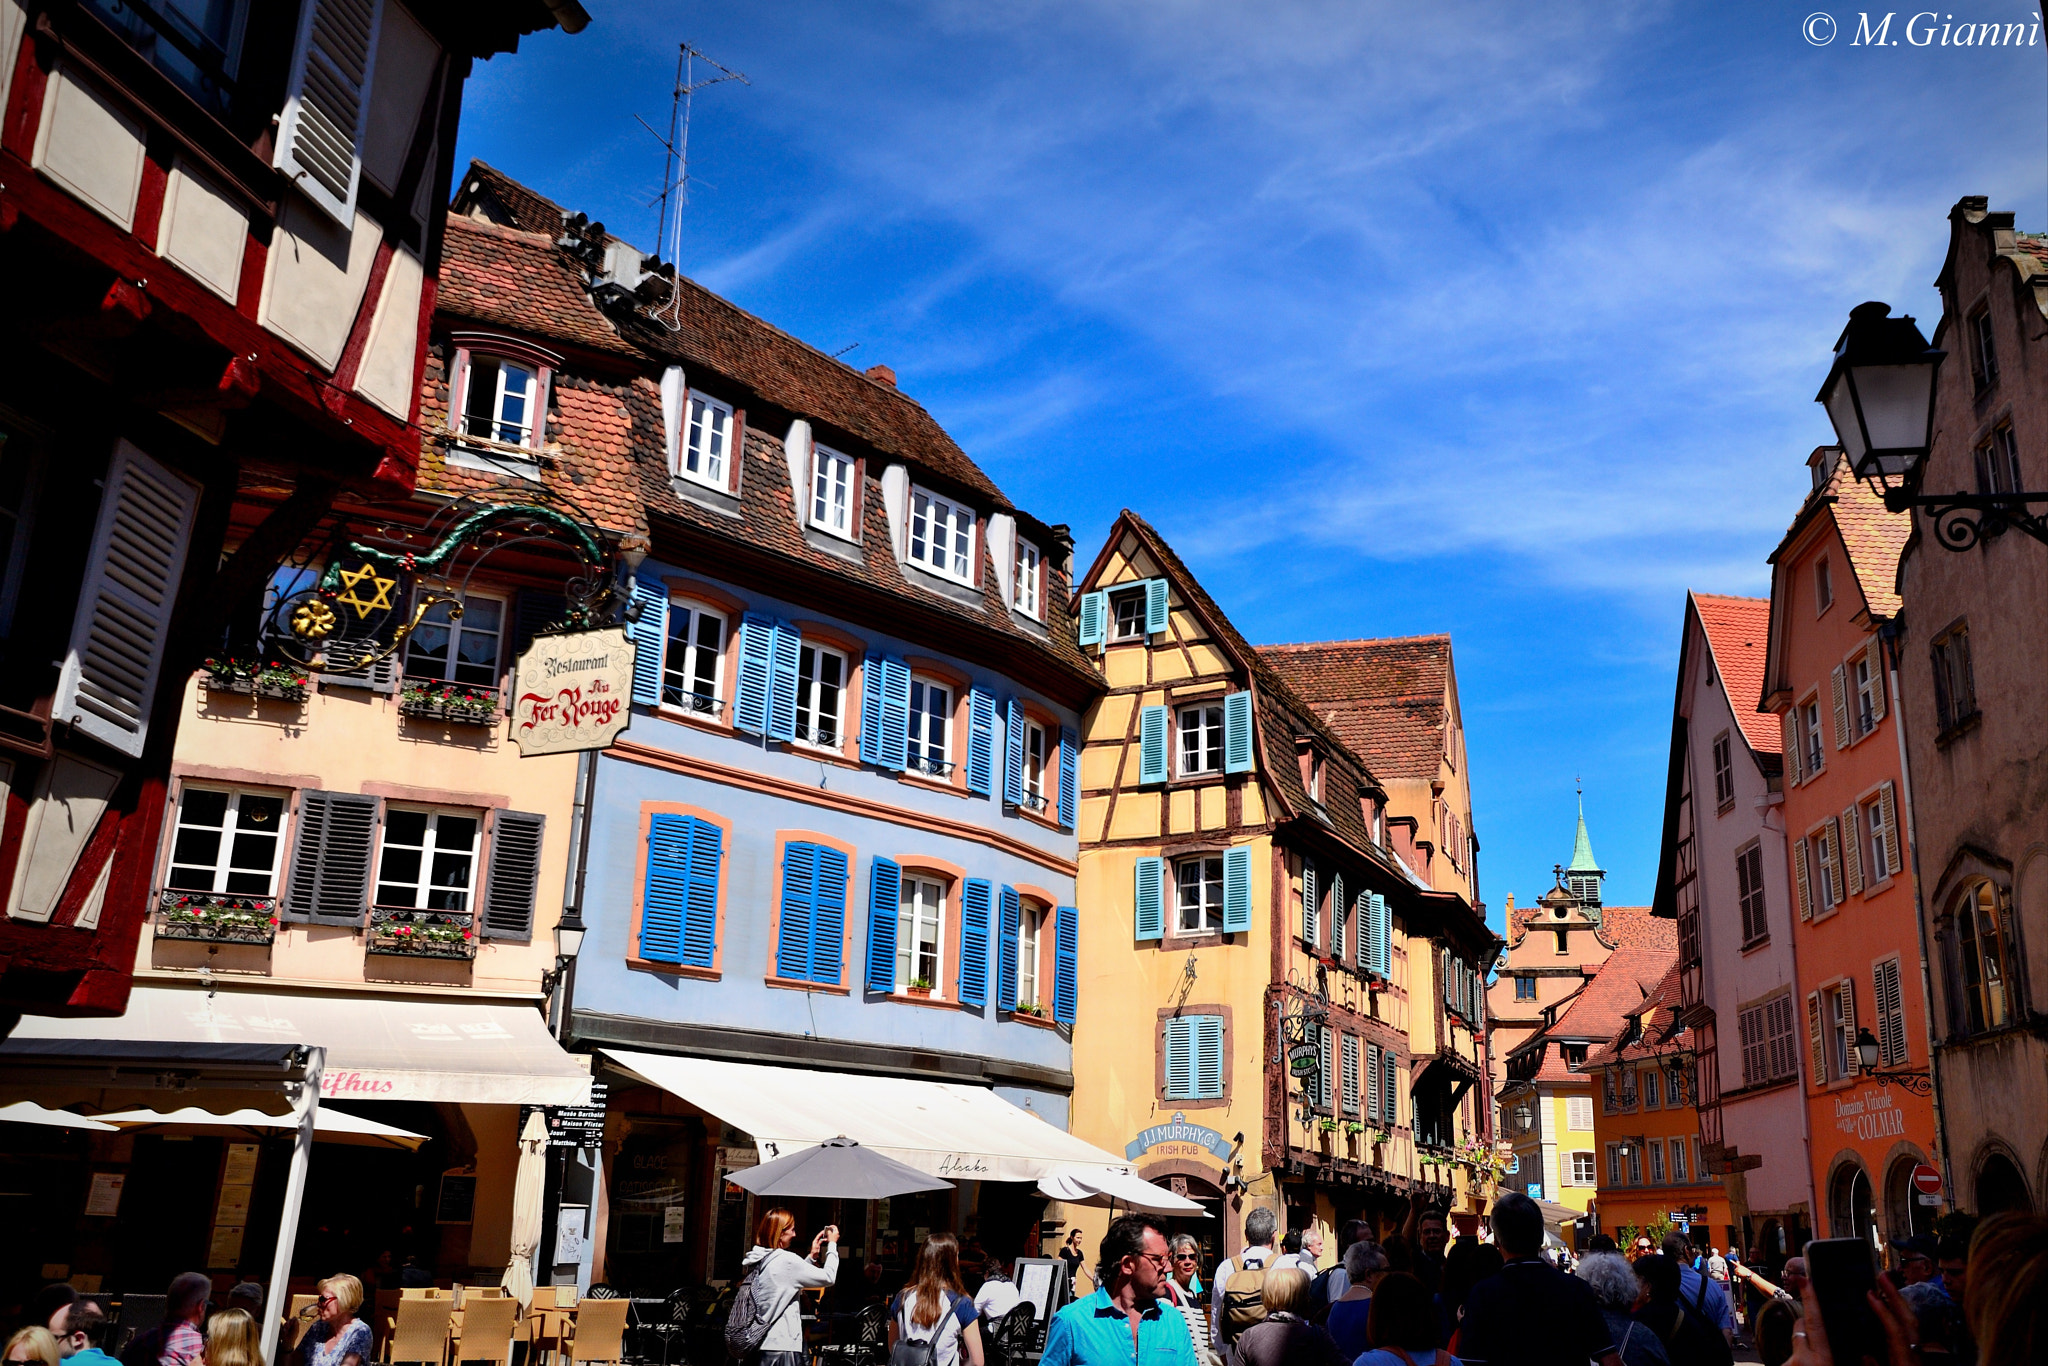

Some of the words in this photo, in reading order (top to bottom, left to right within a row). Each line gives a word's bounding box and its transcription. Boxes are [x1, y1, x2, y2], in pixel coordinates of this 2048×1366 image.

[544, 654, 609, 678] Restaurant
[588, 679, 610, 694] Au
[519, 692, 559, 729] Fer
[558, 685, 621, 729] Rouge
[321, 1072, 393, 1096] ïfhus
[1835, 1095, 1864, 1117] Domaine
[1865, 1087, 1892, 1111] Viticole
[1858, 1108, 1905, 1140] COLMAR
[1157, 1145, 1179, 1155] IRISH
[1182, 1145, 1199, 1155] PUB
